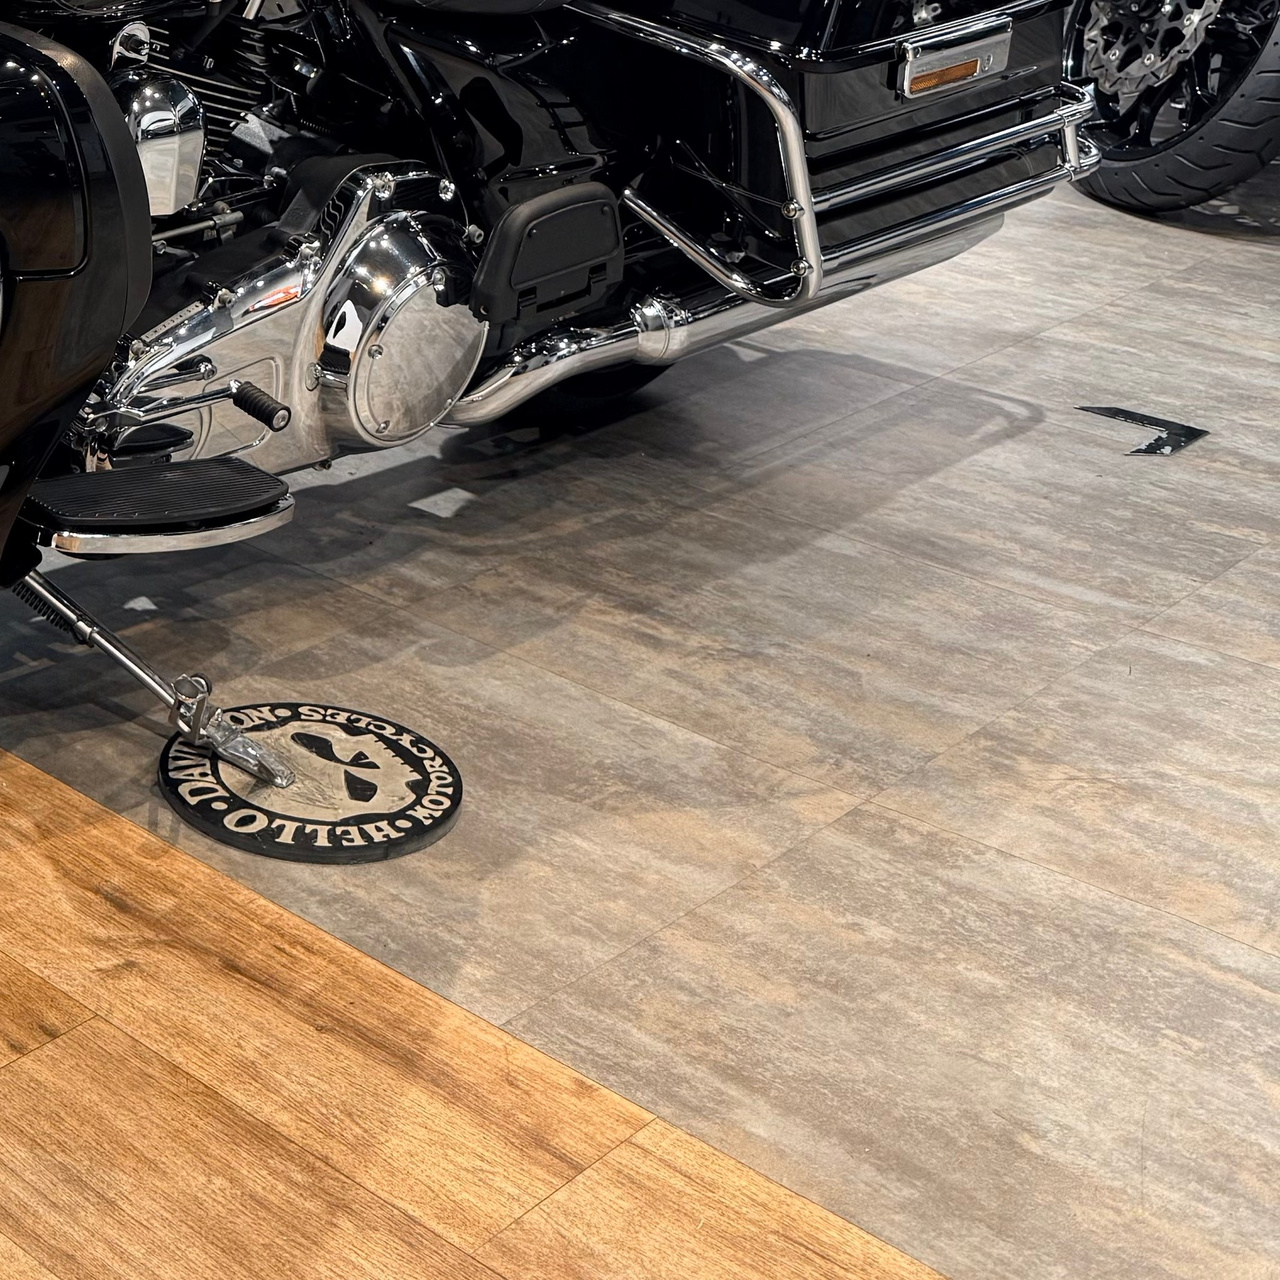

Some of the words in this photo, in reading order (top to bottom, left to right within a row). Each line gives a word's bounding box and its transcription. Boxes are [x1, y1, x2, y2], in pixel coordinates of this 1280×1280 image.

[167, 706, 278, 806] DAVION
[299, 706, 453, 825] MOTORCYCLES
[224, 808, 405, 847] HELLO
